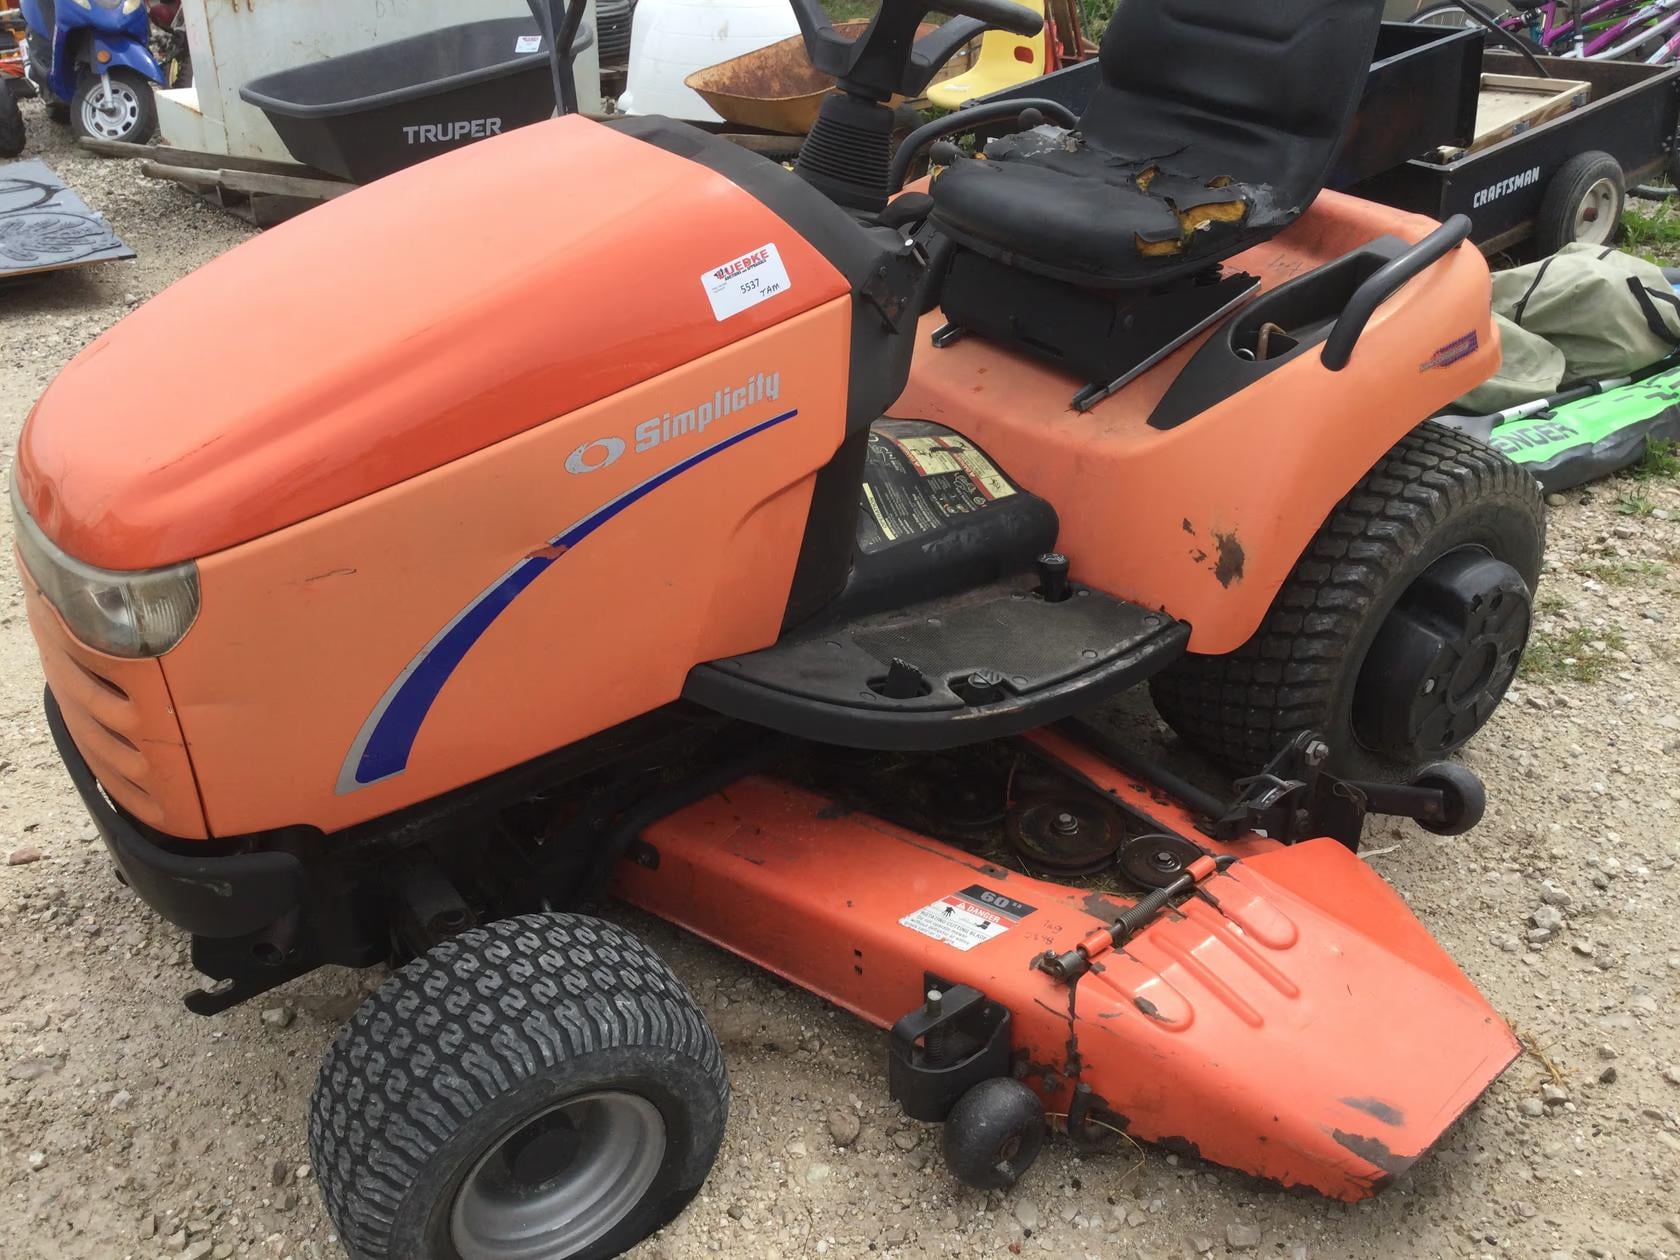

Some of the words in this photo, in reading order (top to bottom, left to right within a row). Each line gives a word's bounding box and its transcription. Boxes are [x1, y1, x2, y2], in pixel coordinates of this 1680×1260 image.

[402, 117, 502, 145] TRUPER
[1473, 166, 1540, 208] CRAFTSMAN
[740, 278, 760, 294] 5537
[634, 372, 780, 454] Simplicity
[980, 890, 1023, 909] 60"
[967, 905, 1001, 924] DANGER
